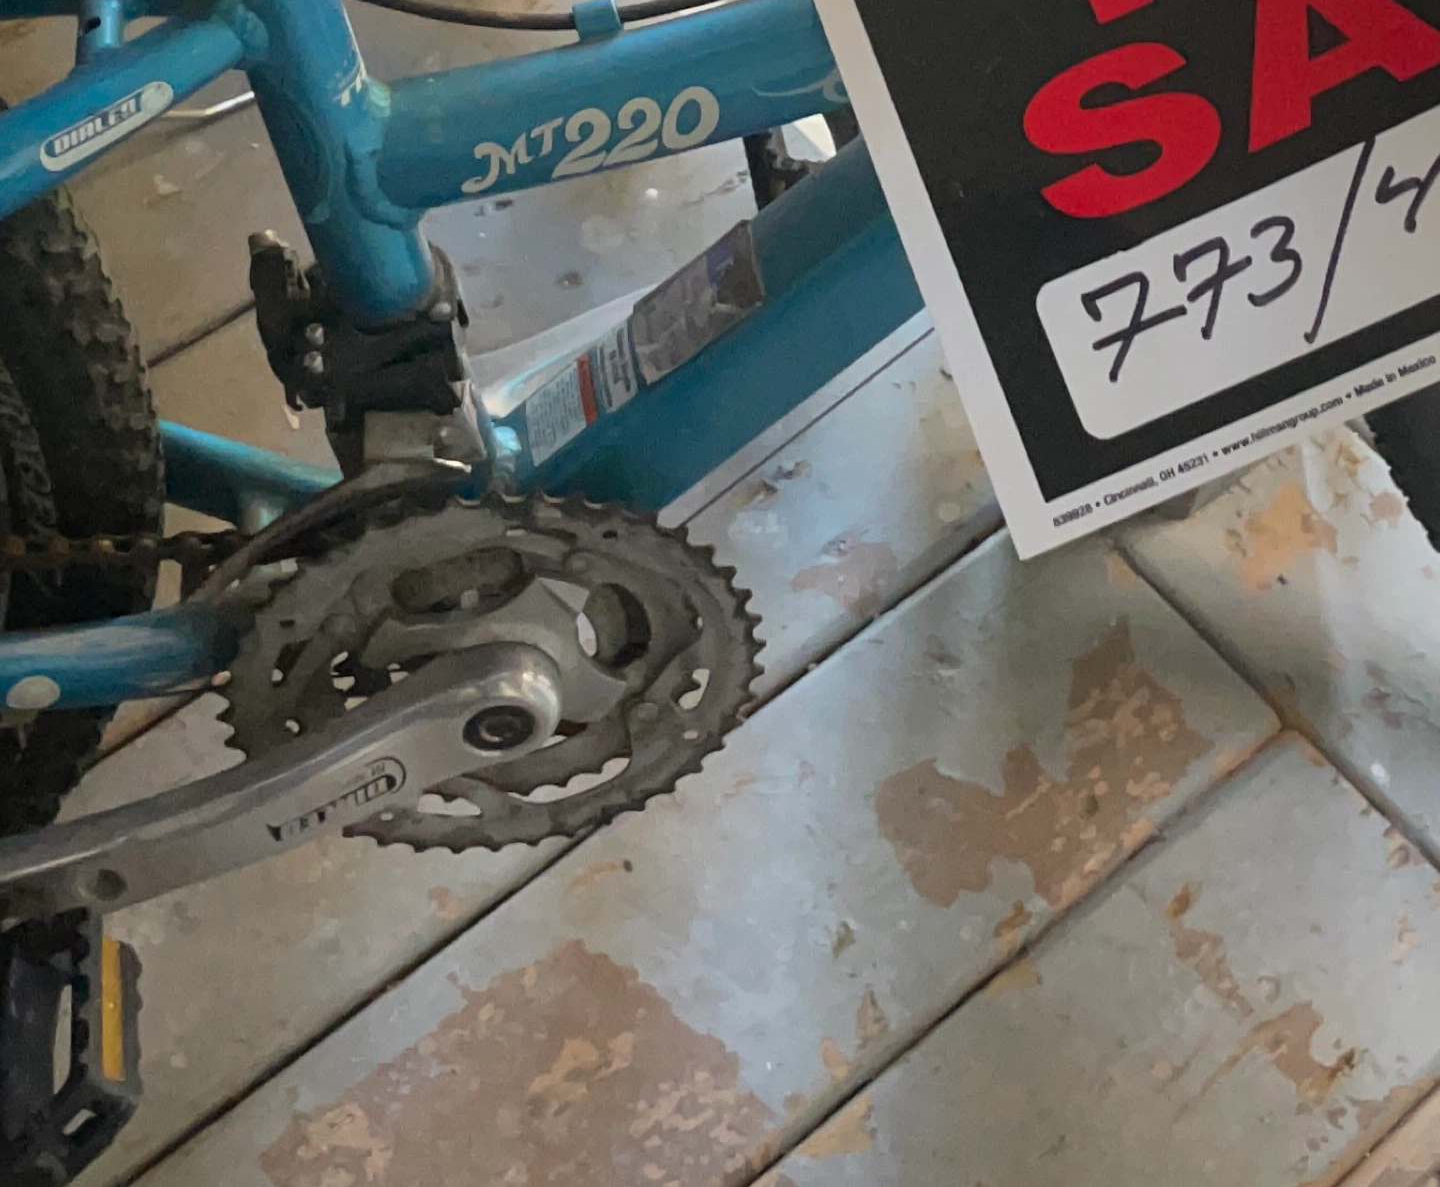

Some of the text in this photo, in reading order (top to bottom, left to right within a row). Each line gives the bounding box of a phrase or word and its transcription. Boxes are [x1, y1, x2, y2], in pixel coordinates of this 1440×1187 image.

[1159, 466, 1176, 481] OH
[1353, 378, 1385, 397] Made
[1385, 371, 1397, 383] in
[1397, 355, 1437, 377] Mexico
